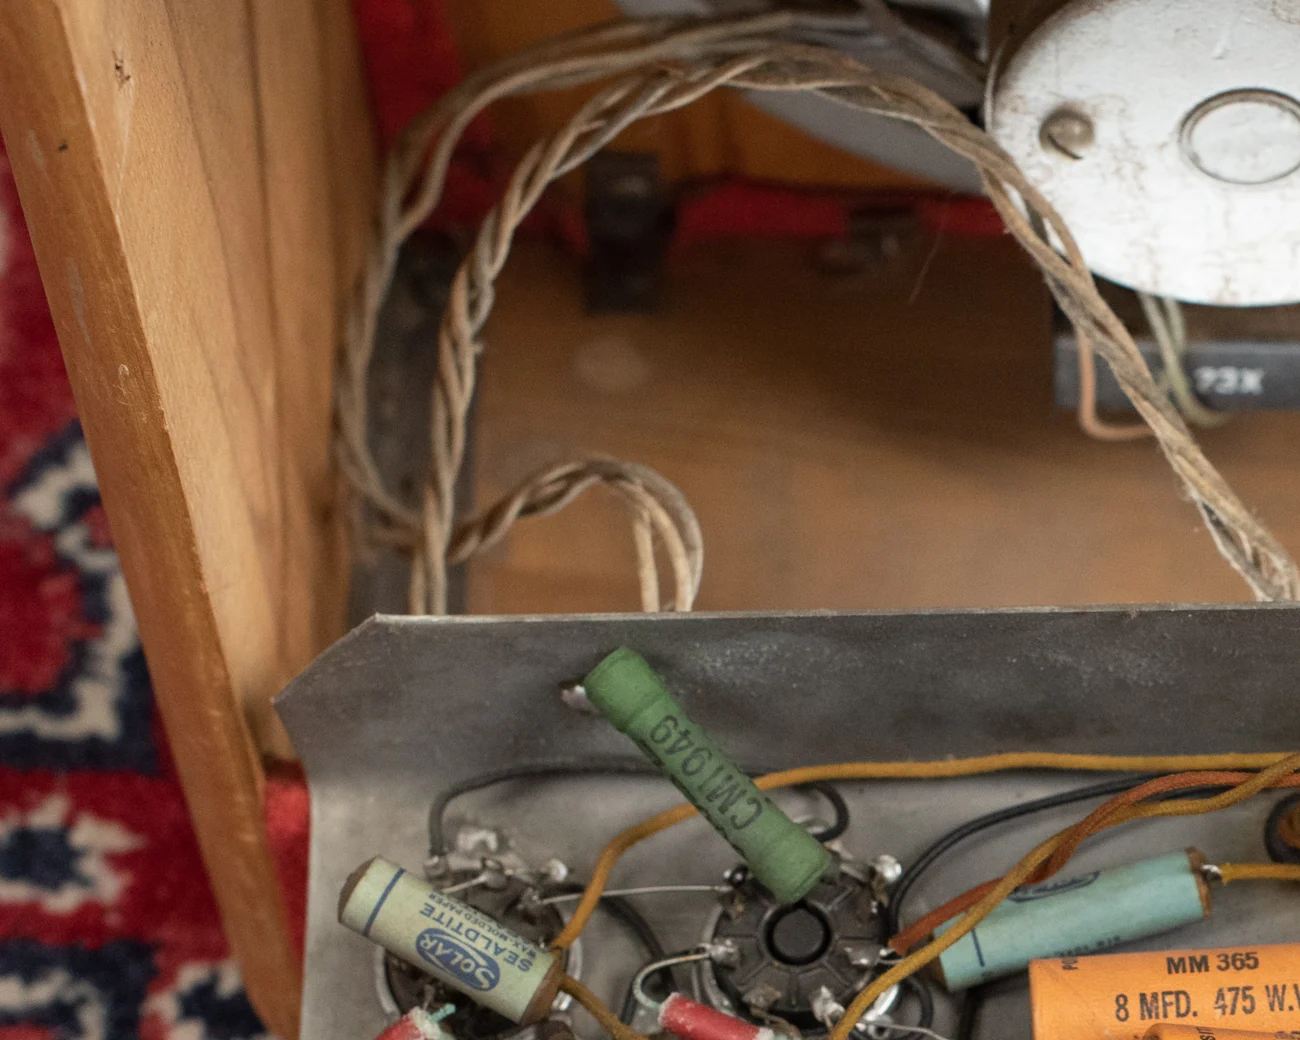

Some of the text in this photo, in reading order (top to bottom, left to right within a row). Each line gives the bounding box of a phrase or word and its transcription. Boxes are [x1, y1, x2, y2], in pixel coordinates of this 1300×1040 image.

[419, 902, 534, 972] SEALDTITE
[419, 933, 496, 990] SOLAR
[1166, 951, 1260, 975] MM 365
[1115, 993, 1130, 1022] 8
[1138, 990, 1199, 1021] MFD.
[1213, 985, 1256, 1016] 475
